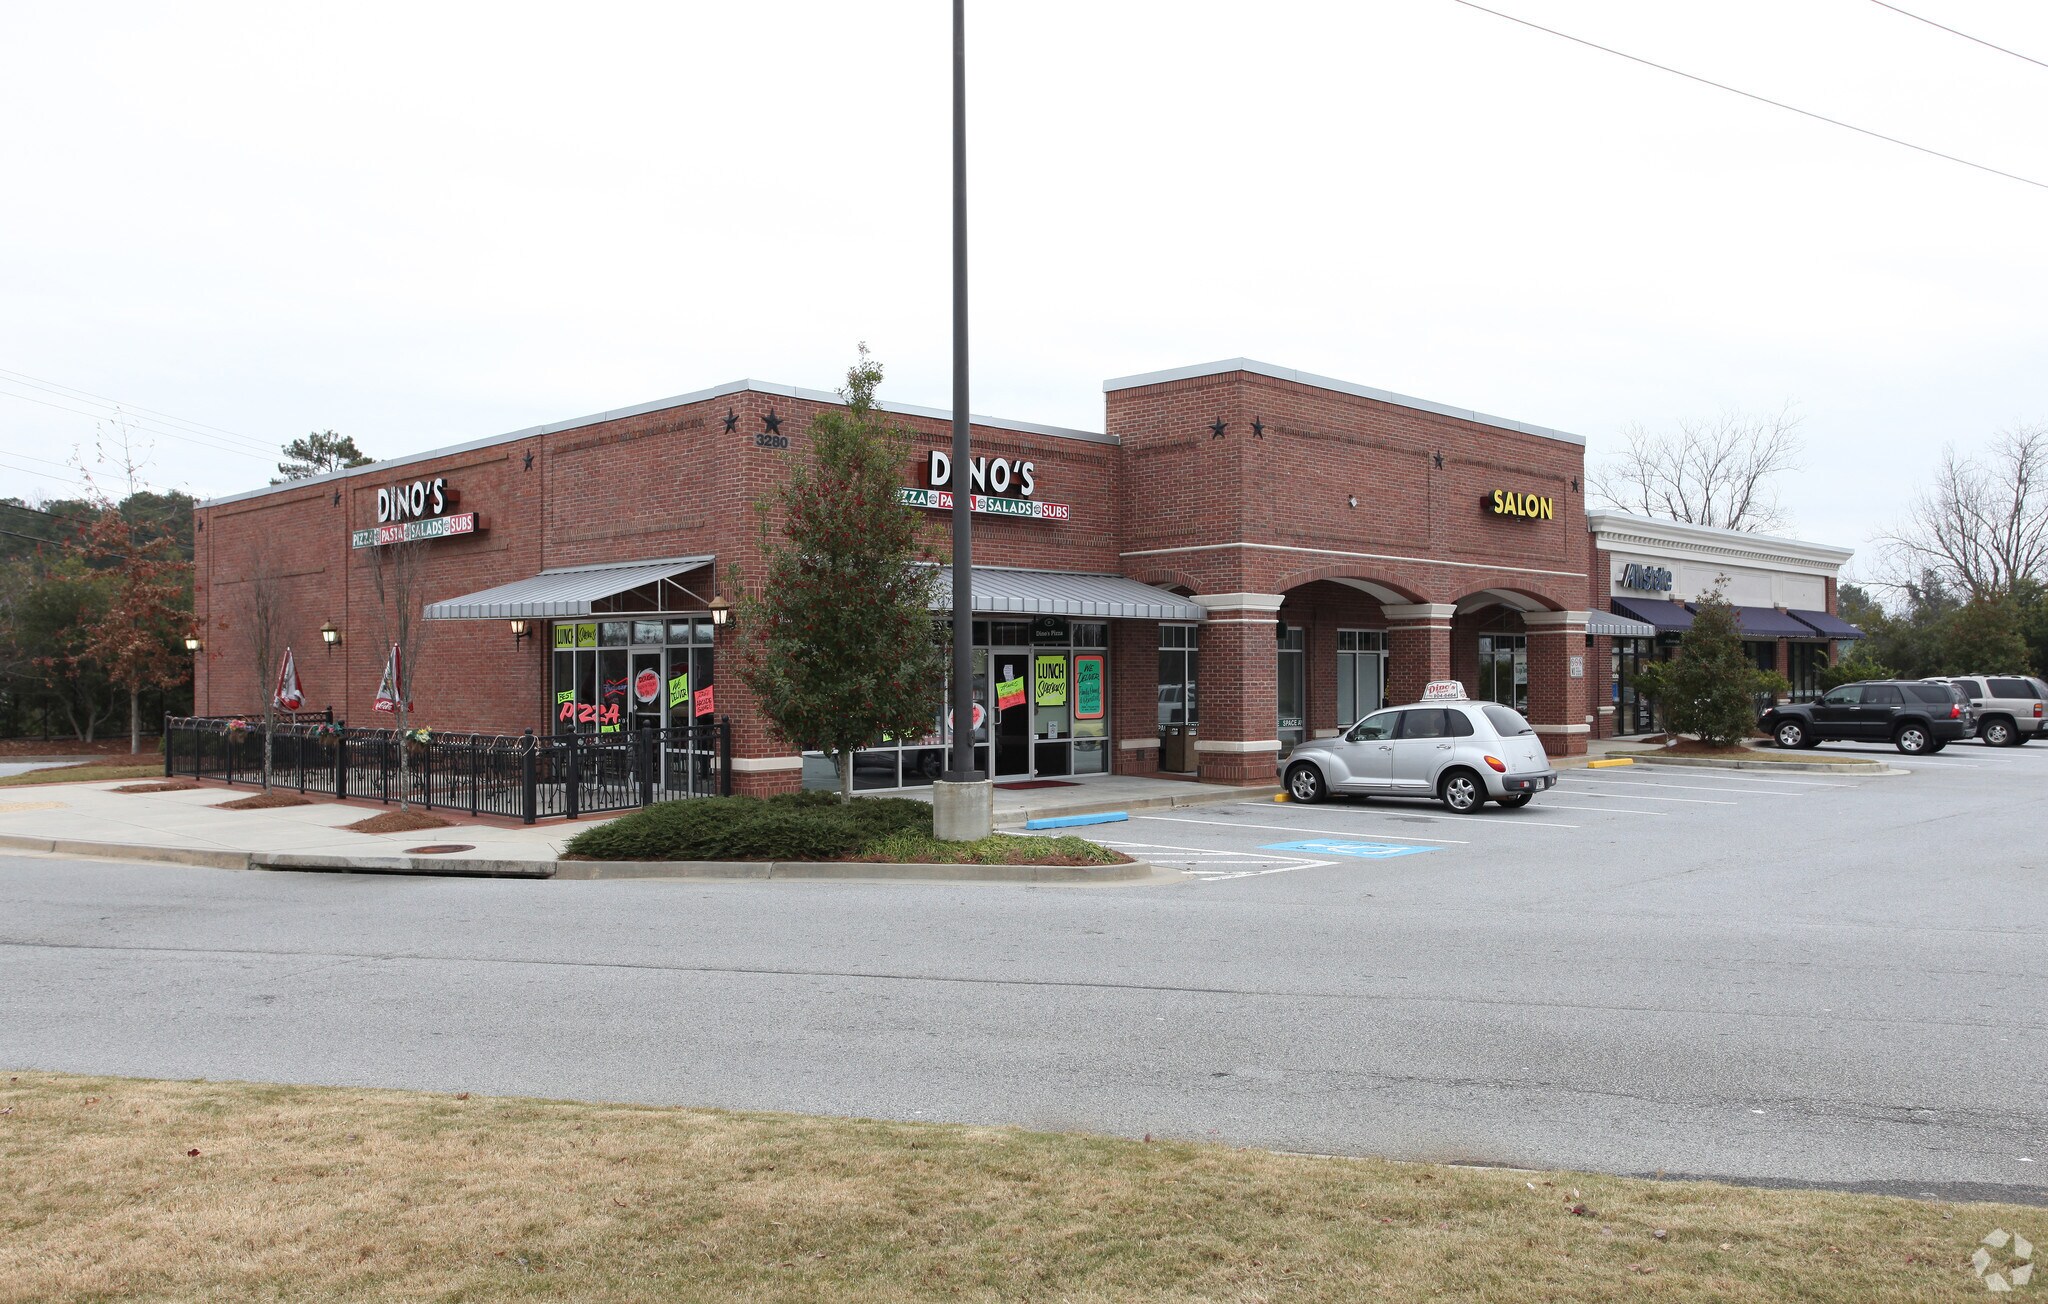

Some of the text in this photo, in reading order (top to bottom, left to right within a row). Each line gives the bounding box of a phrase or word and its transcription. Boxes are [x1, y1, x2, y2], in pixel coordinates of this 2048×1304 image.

[756, 434, 788, 448] 3280
[931, 451, 1034, 496] DNO'S
[377, 478, 444, 523] DINO'S
[988, 497, 1032, 515] SALADS
[1043, 504, 1069, 519] SUBS
[1494, 489, 1553, 519] SALON
[353, 515, 472, 547] PIZZA PASTA SALADS SUBS
[1624, 563, 1673, 592] Allstate
[1038, 663, 1064, 679] LUNCH
[1283, 719, 1299, 727] SPACE
